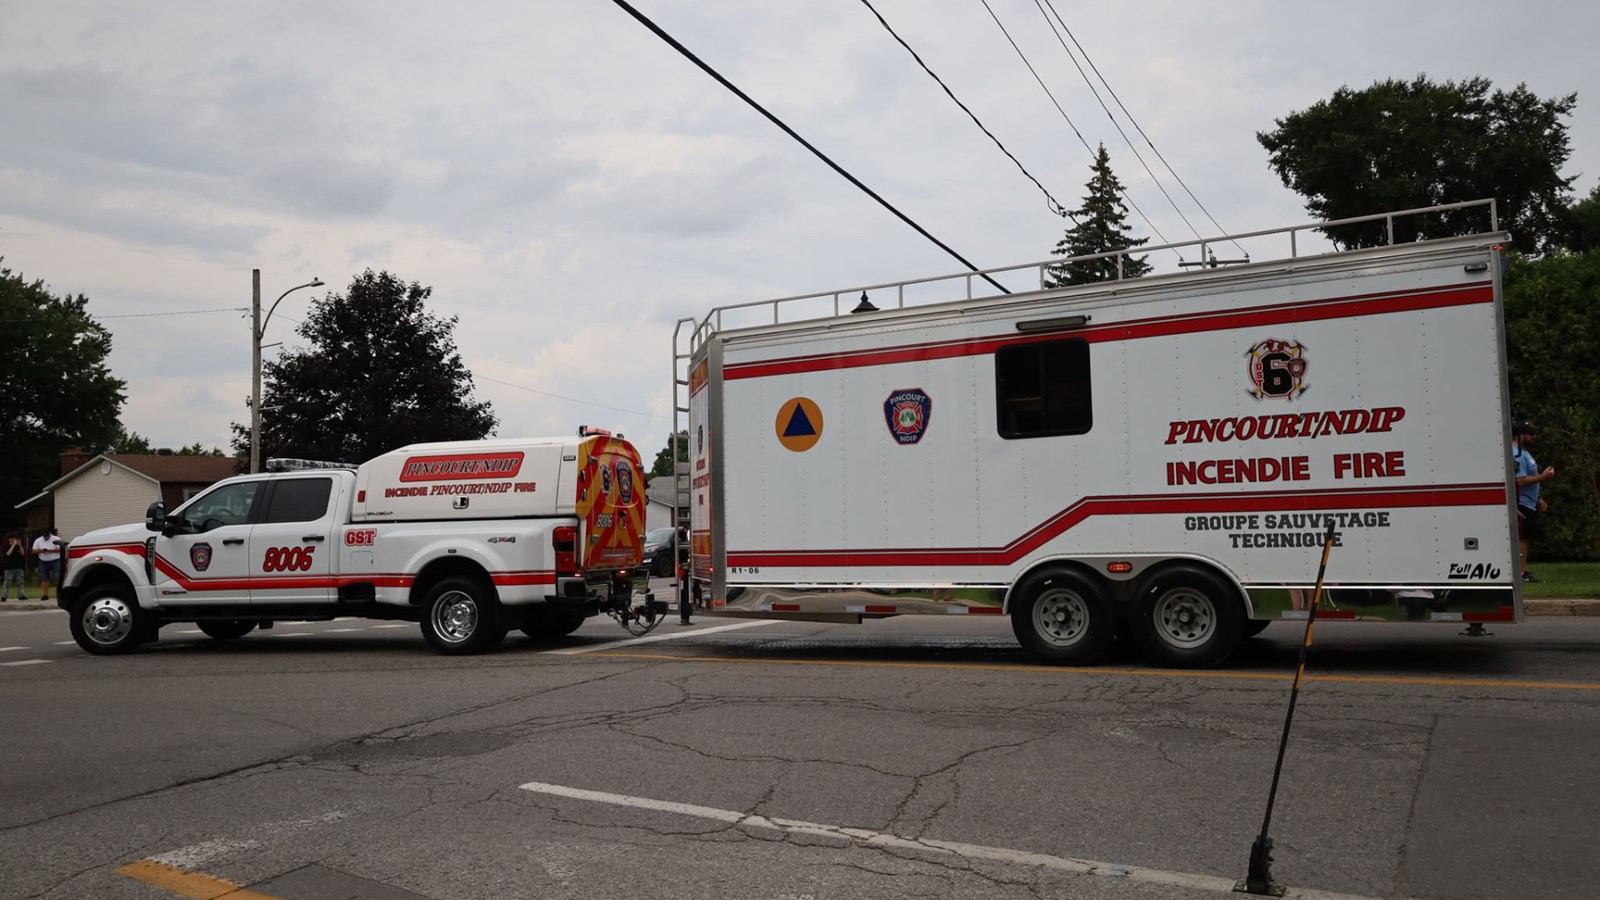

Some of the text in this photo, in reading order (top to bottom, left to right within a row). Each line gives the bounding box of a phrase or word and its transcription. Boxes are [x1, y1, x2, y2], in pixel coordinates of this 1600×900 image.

[1259, 351, 1295, 397] 6
[890, 393, 926, 405] PINCOURT
[1164, 406, 1406, 445] PINCOURT/NDIP
[900, 434, 918, 442] NDIP
[405, 457, 519, 477] PINCOURT/NDIP
[1166, 451, 1406, 486] INCENDIE FIRE
[385, 482, 536, 498] INCENDIE PINCOURT/NDIP FIRE
[597, 512, 613, 528] 8006
[1185, 511, 1391, 531] GROUPE SAUVETAGE
[344, 528, 377, 547] GST
[1228, 532, 1343, 549] TECHNIQUE
[262, 546, 316, 572] 8006
[1469, 562, 1501, 580] Alu
